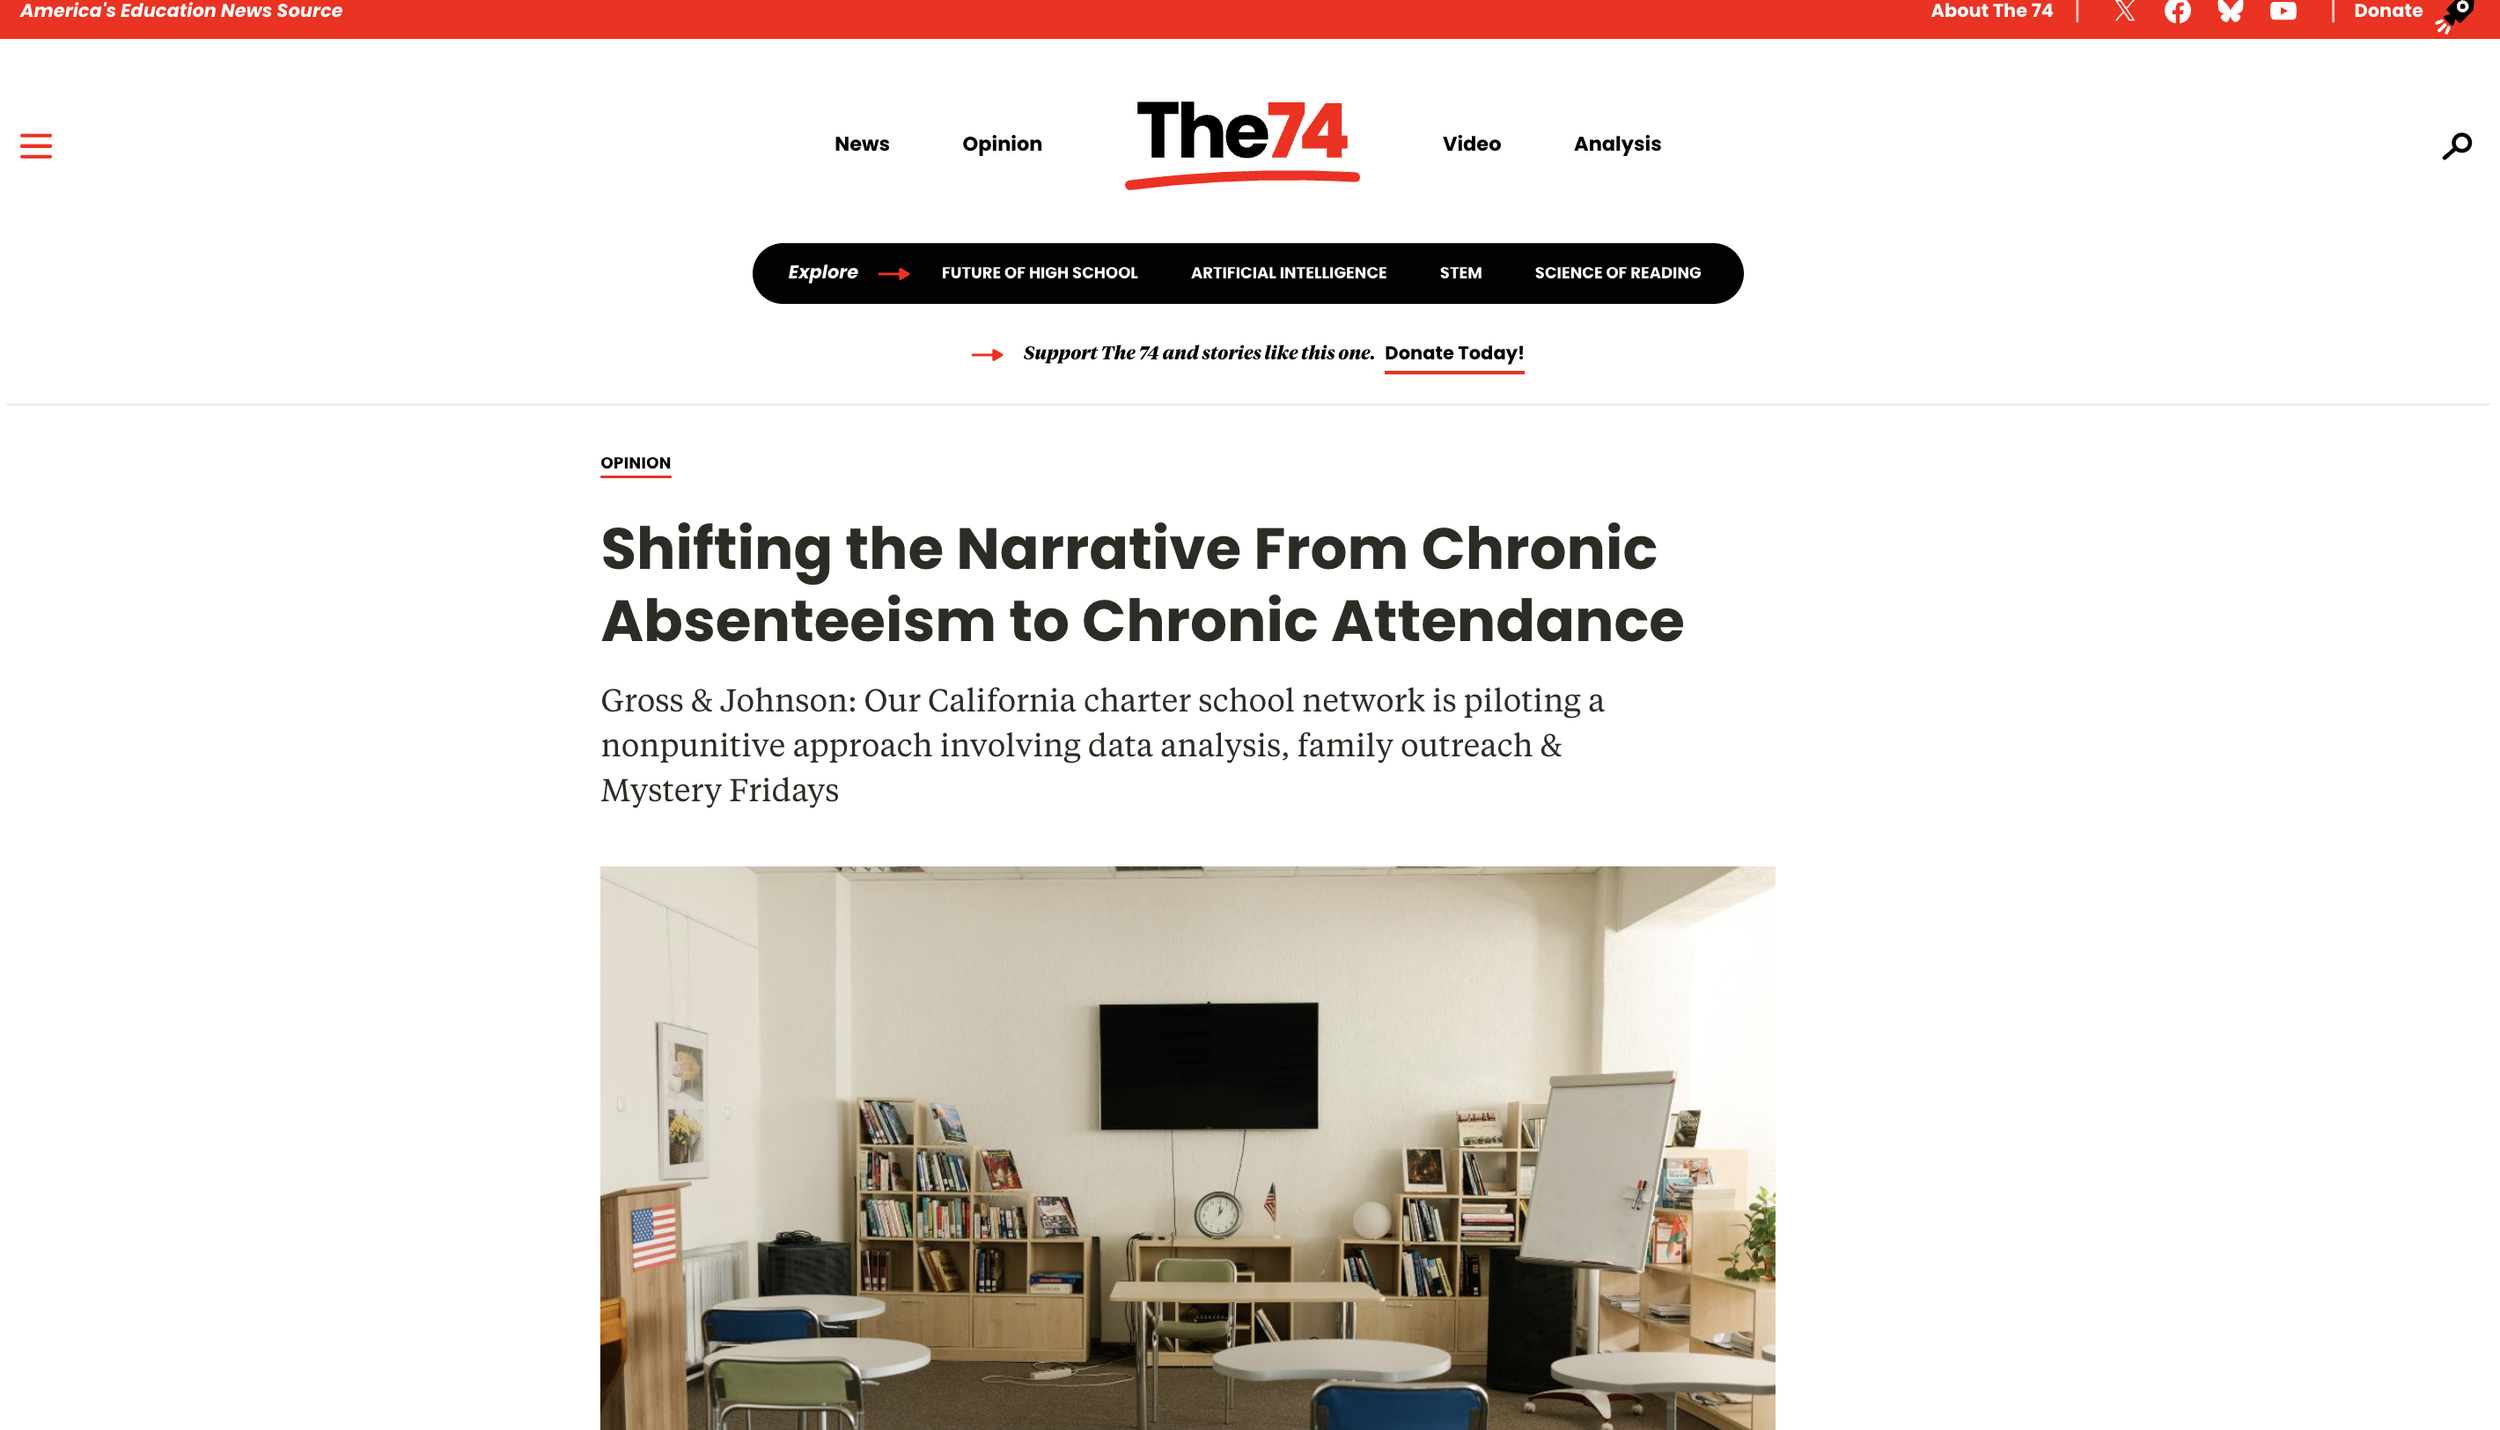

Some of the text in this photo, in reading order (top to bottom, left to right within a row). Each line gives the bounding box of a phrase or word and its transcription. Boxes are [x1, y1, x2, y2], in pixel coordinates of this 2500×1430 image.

[20, 2, 343, 18] America's Education News Source
[1930, 2, 2054, 18] About The 74
[2354, 3, 2424, 18] Donate
[835, 136, 890, 152] News
[962, 134, 1043, 157] Opinion
[1442, 134, 1502, 152] Video
[1573, 134, 1662, 157] Analysis
[788, 264, 859, 284] Explore
[942, 266, 1139, 279] FUTURE OF HIGH SCHOOL
[1191, 266, 1387, 279] ARTIFICIAL INTELLIGENCE
[1440, 266, 1482, 279] STEM
[1535, 266, 1702, 279] SCIENCE OF READING
[1023, 344, 1375, 364] Support The 74 and stories like this one.
[1385, 345, 1524, 365] Donate Today!
[600, 456, 671, 470] OPINION
[602, 521, 1657, 586] Shifting the Narrative From Chronic
[601, 594, 1684, 642] Absenteeism to Chronic Attendance
[601, 686, 1606, 719] Gross & Johnson: Our California charter school network is piloting a
[601, 731, 1562, 764] nonpunitive approach involving data analysis, family outreach &
[600, 776, 839, 809] Mystery Fridays
